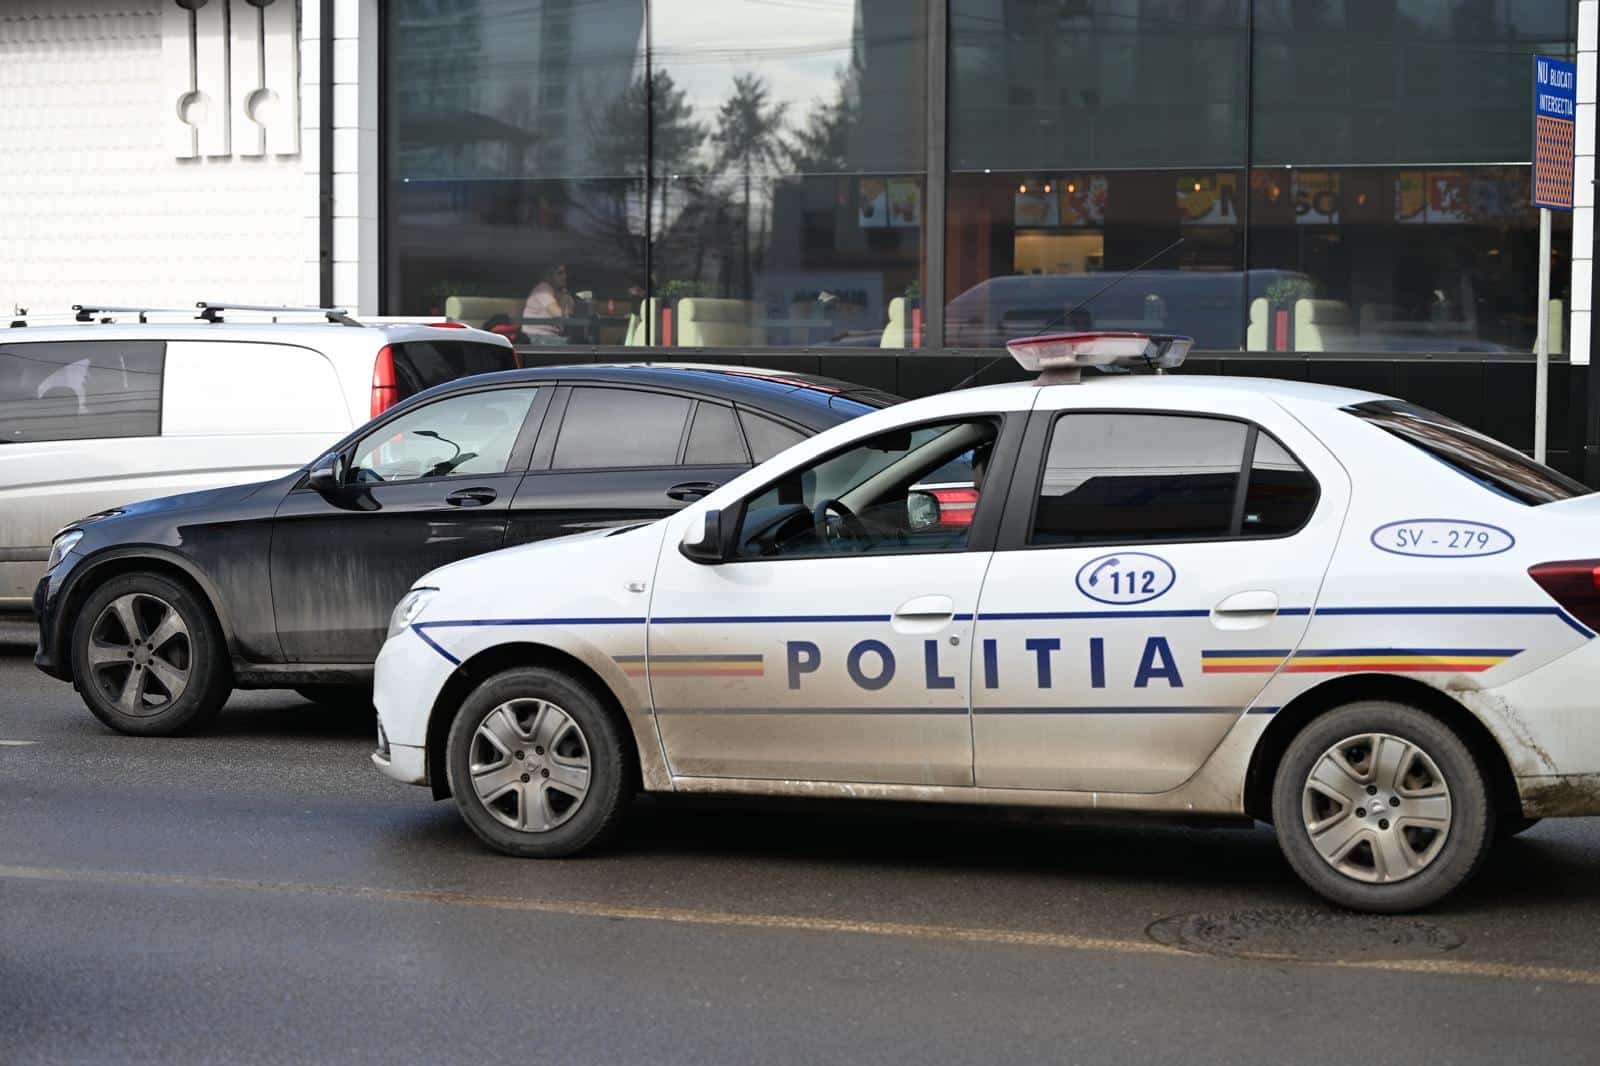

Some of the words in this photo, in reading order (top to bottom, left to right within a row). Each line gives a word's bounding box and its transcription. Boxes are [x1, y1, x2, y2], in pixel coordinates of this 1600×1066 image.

[1537, 60, 1548, 84] NU
[1396, 528, 1423, 547] SV
[1448, 530, 1489, 549] 279
[1110, 570, 1155, 595] 112
[786, 636, 1184, 690] POLITIA
